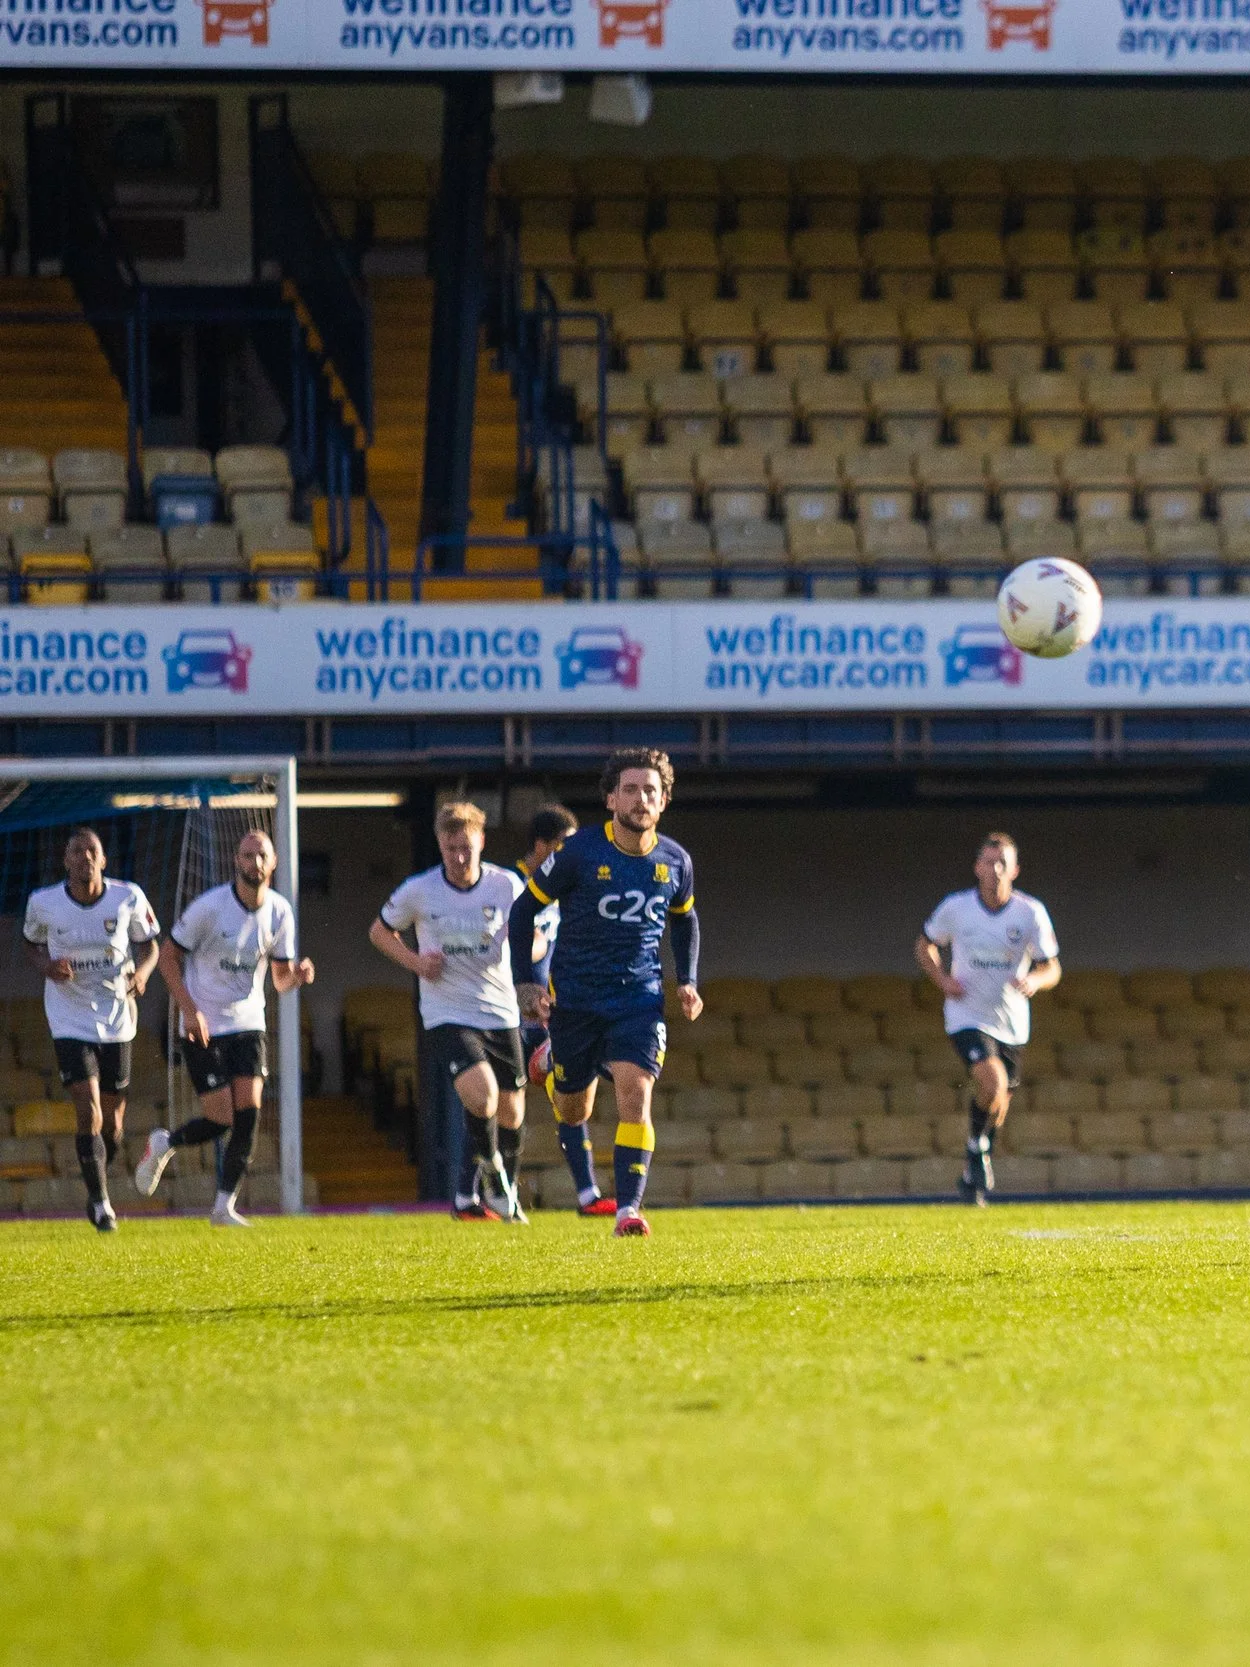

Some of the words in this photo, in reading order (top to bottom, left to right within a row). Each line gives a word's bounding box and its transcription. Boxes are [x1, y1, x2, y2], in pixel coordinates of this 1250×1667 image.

[0, 20, 178, 46] vans.com
[341, 23, 574, 56] anyvans.com
[733, 26, 963, 58] anyvans.com
[316, 617, 541, 658] wefinance
[706, 611, 925, 654] wefinance
[316, 664, 541, 699] anycar.com
[705, 661, 927, 696] anycar.com
